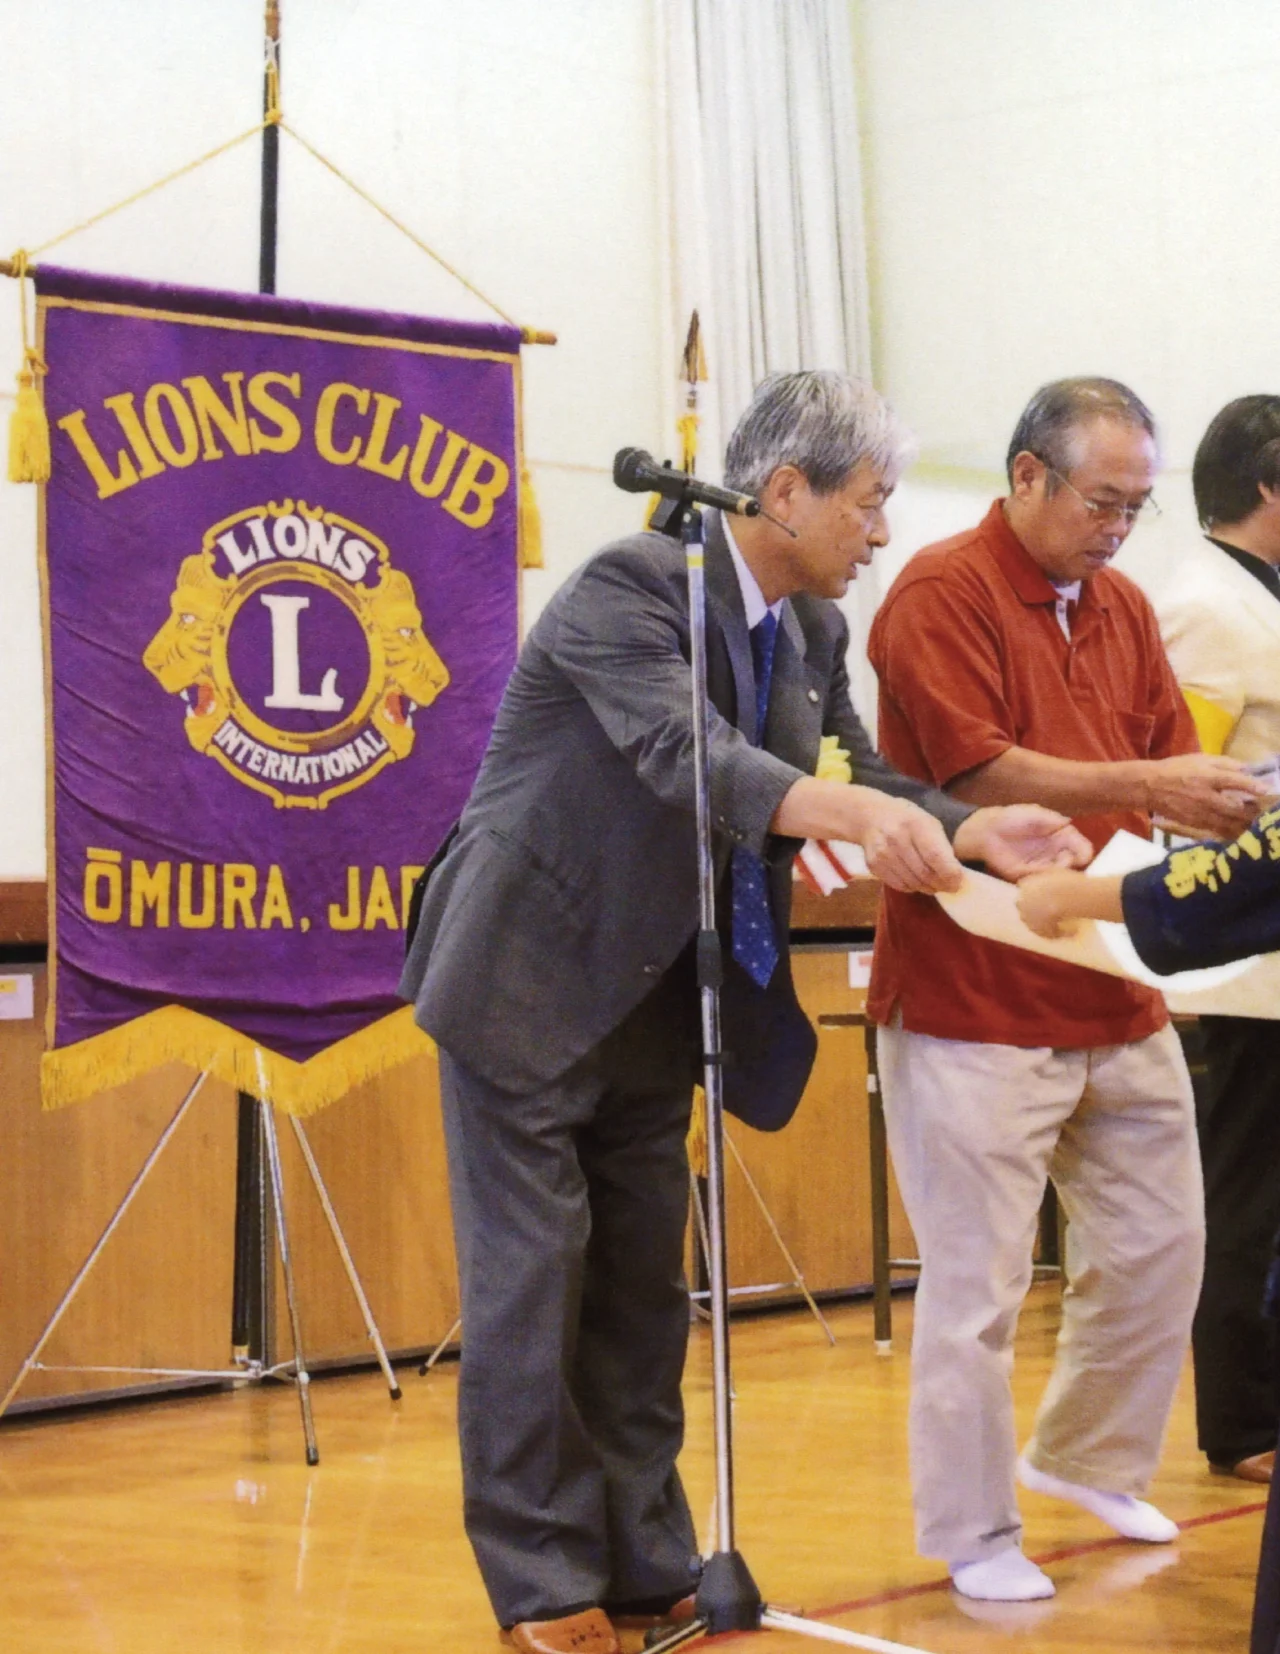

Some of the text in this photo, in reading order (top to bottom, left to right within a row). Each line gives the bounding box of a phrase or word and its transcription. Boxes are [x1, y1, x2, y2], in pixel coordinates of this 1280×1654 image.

[59, 371, 510, 529] LIONS CLUB
[217, 514, 376, 582] LIONS
[260, 593, 344, 712] L
[212, 719, 389, 785] INTERNATIONAL
